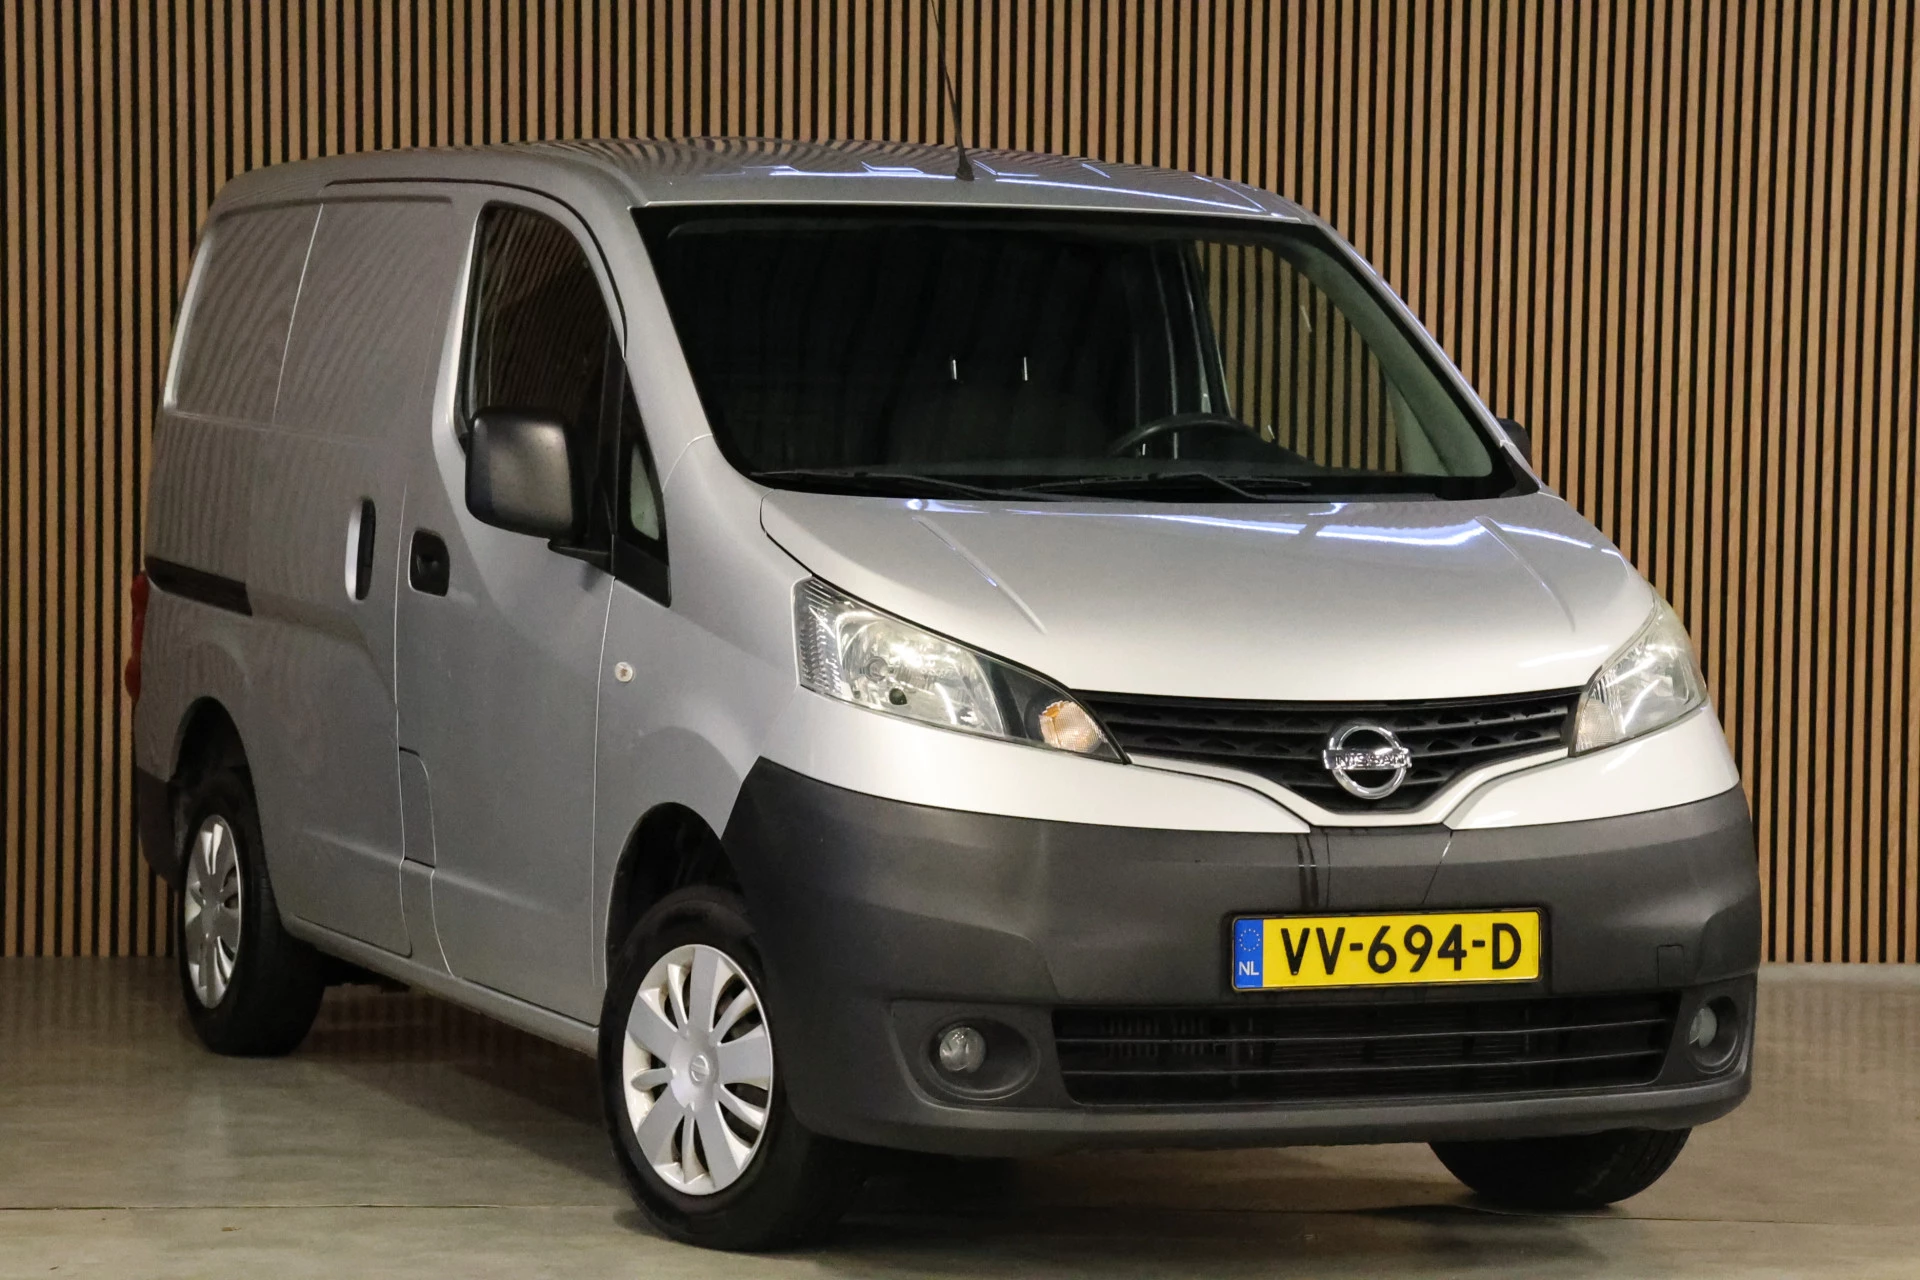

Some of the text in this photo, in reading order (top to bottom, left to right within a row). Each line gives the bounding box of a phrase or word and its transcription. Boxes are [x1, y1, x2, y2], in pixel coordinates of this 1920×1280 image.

[1335, 752, 1406, 768] NISSAN
[1280, 922, 1522, 976] VV-694-D
[1238, 961, 1260, 976] NL
